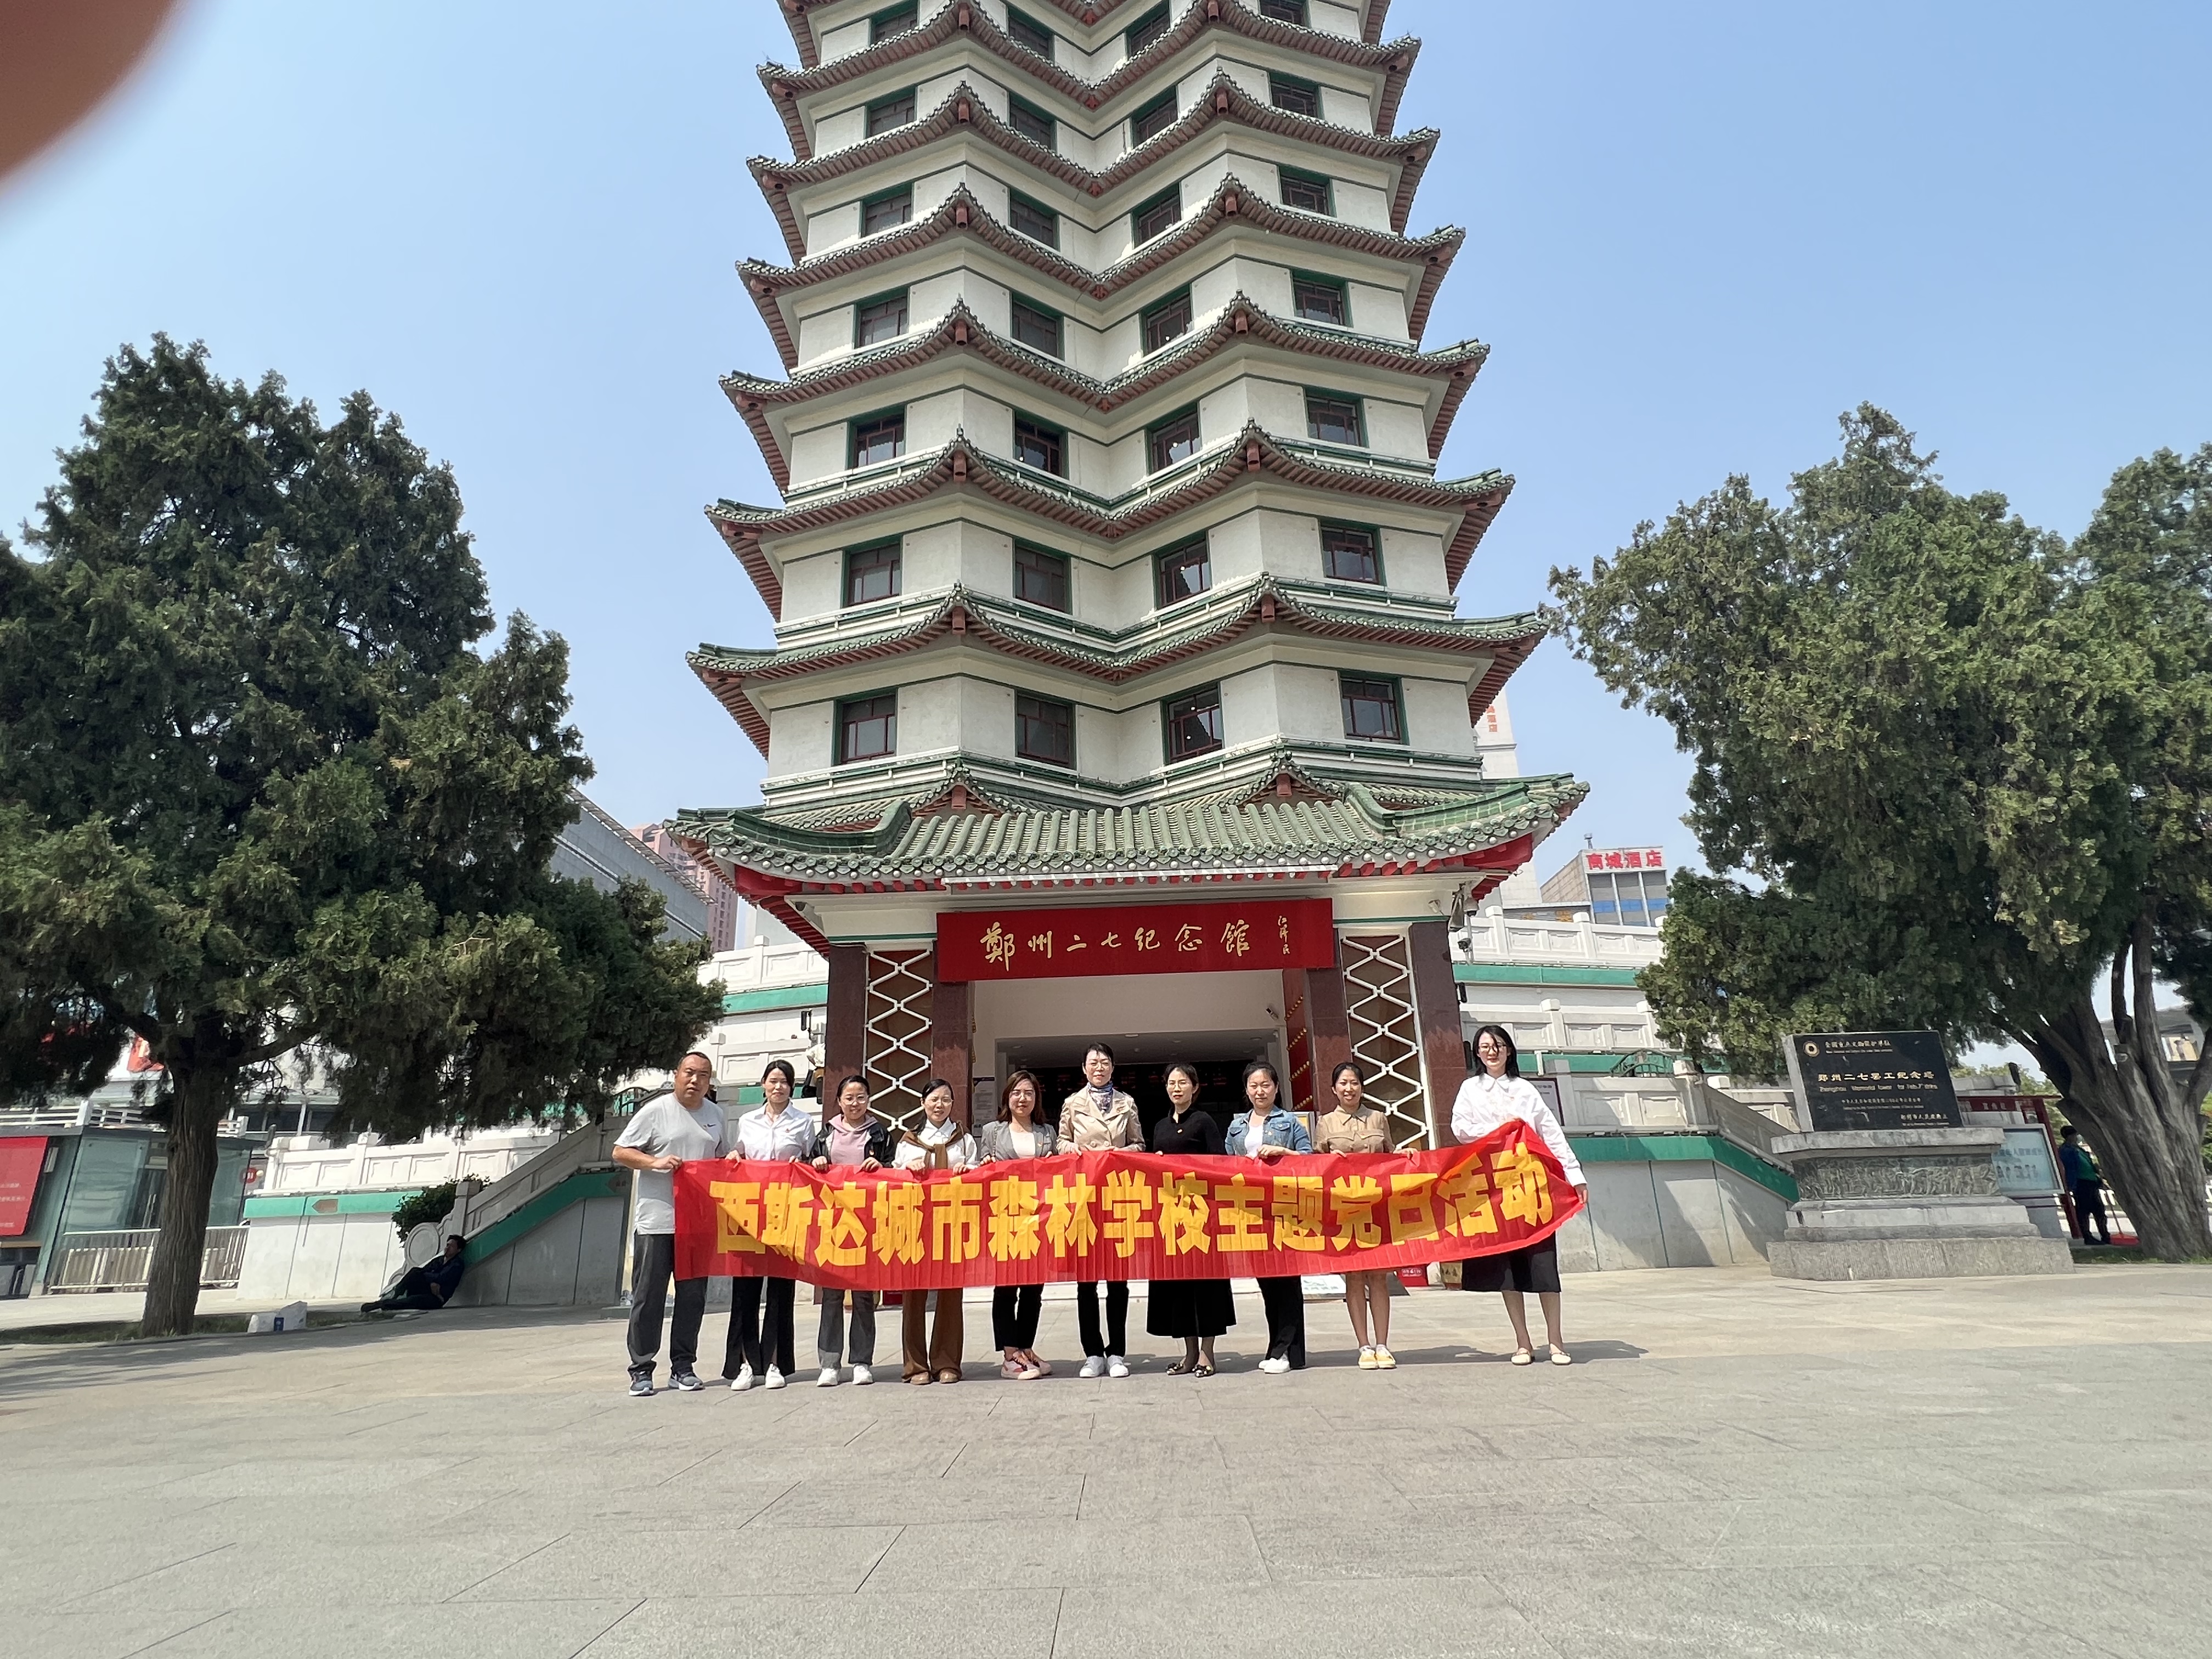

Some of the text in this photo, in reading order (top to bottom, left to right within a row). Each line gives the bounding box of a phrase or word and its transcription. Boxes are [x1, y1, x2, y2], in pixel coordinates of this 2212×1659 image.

[1586, 850, 1662, 870] 商城酒店
[709, 1142, 1554, 1266] 西斯达城市森林学校主题党日活动
